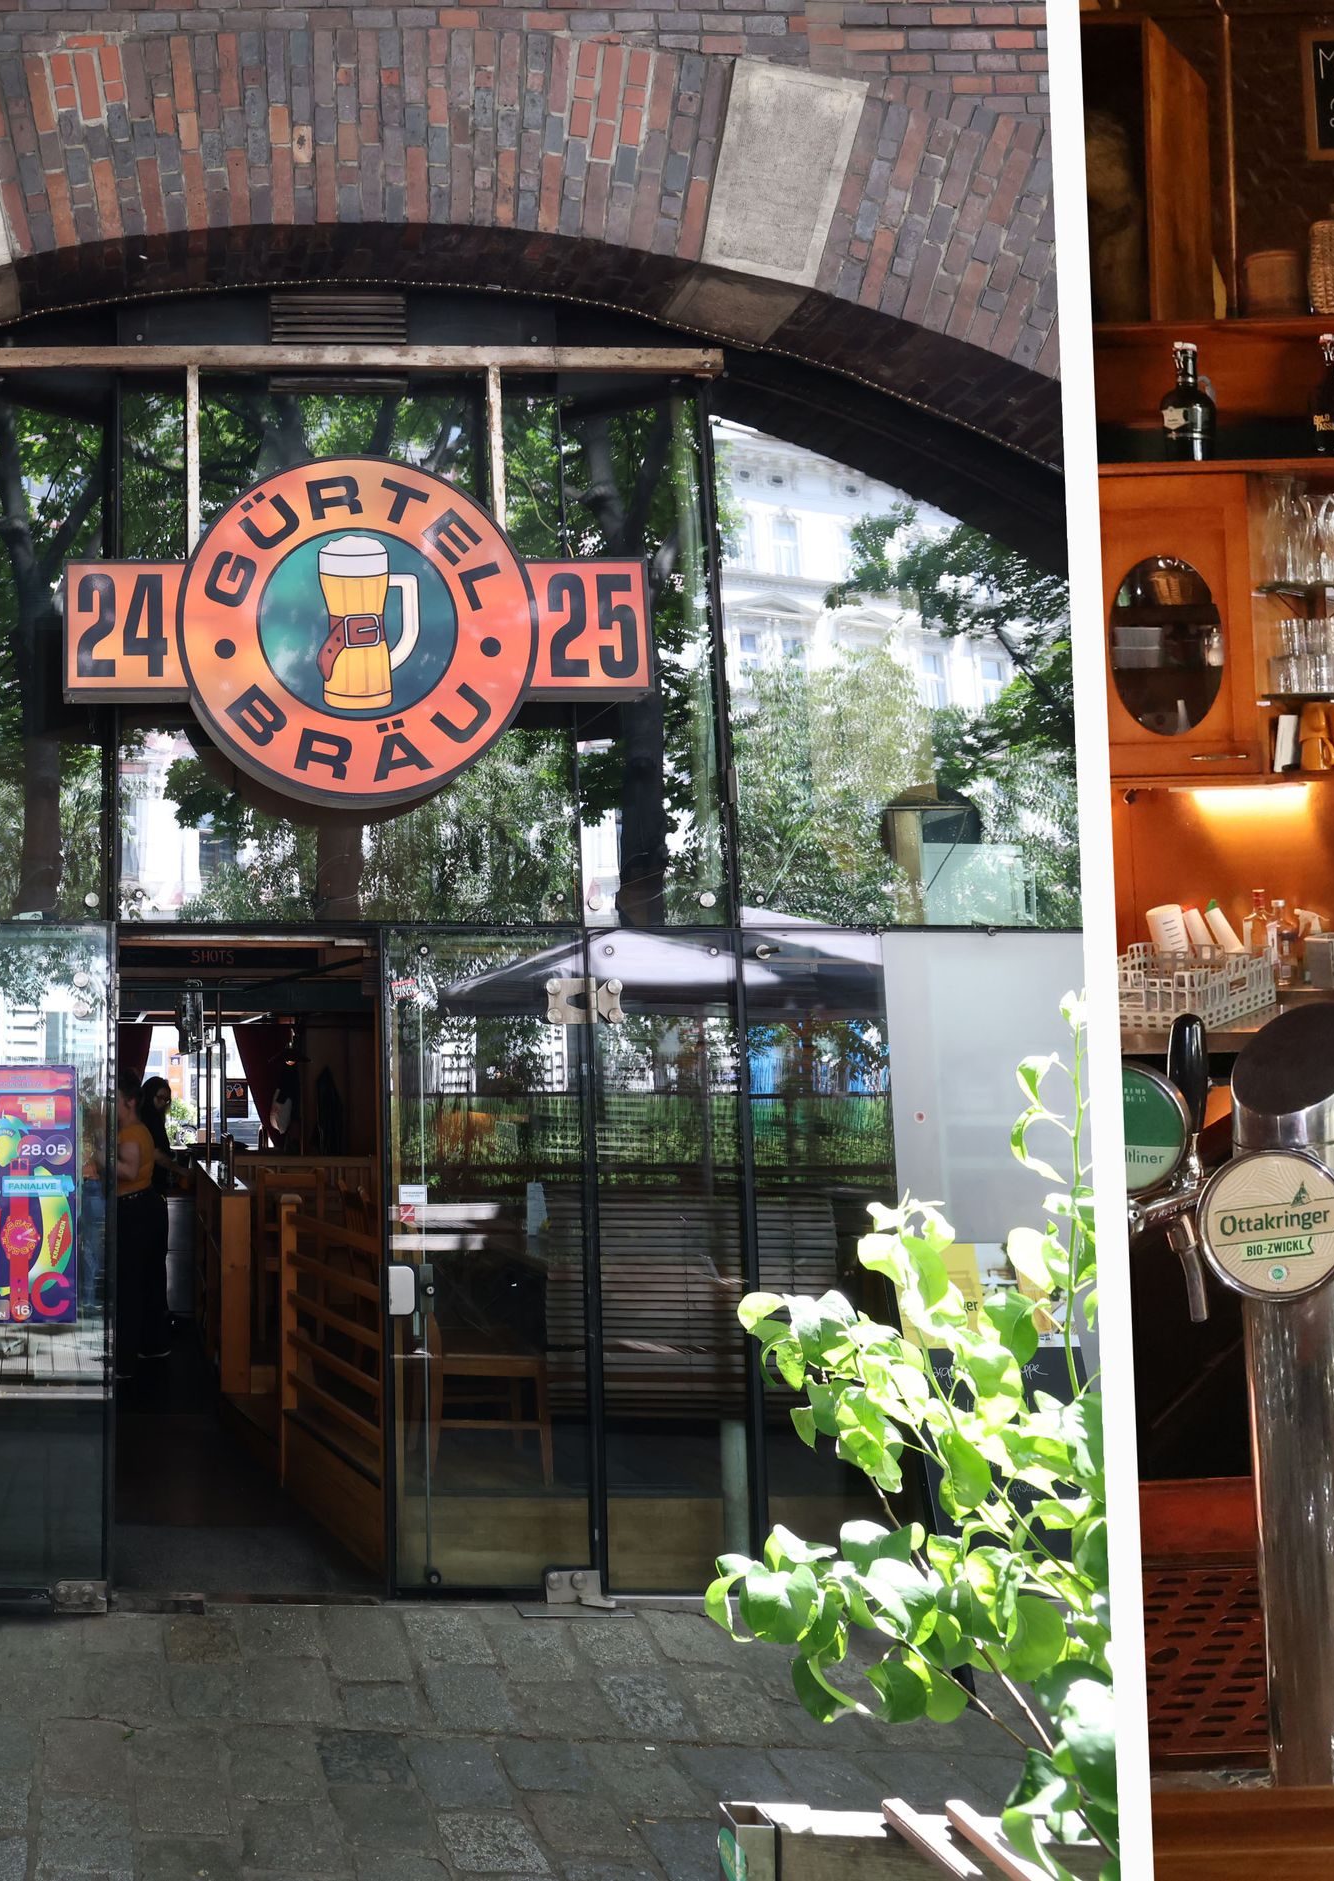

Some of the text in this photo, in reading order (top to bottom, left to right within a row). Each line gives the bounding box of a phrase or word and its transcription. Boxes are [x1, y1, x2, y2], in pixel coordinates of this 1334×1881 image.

[204, 474, 503, 610] GÜRTEL
[76, 573, 169, 678] 24
[547, 573, 640, 678] 25
[224, 680, 493, 783] BRÄU
[21, 1144, 70, 1156] 28.05.
[1125, 1149, 1165, 1164] ltliner
[52, 1220, 66, 1260] KRAMLADEN
[1219, 1207, 1330, 1237] Ottakringer
[1246, 1241, 1305, 1257] BIO-ZWICKL
[14, 1304, 30, 1315] 16
[30, 1271, 71, 1317] C
